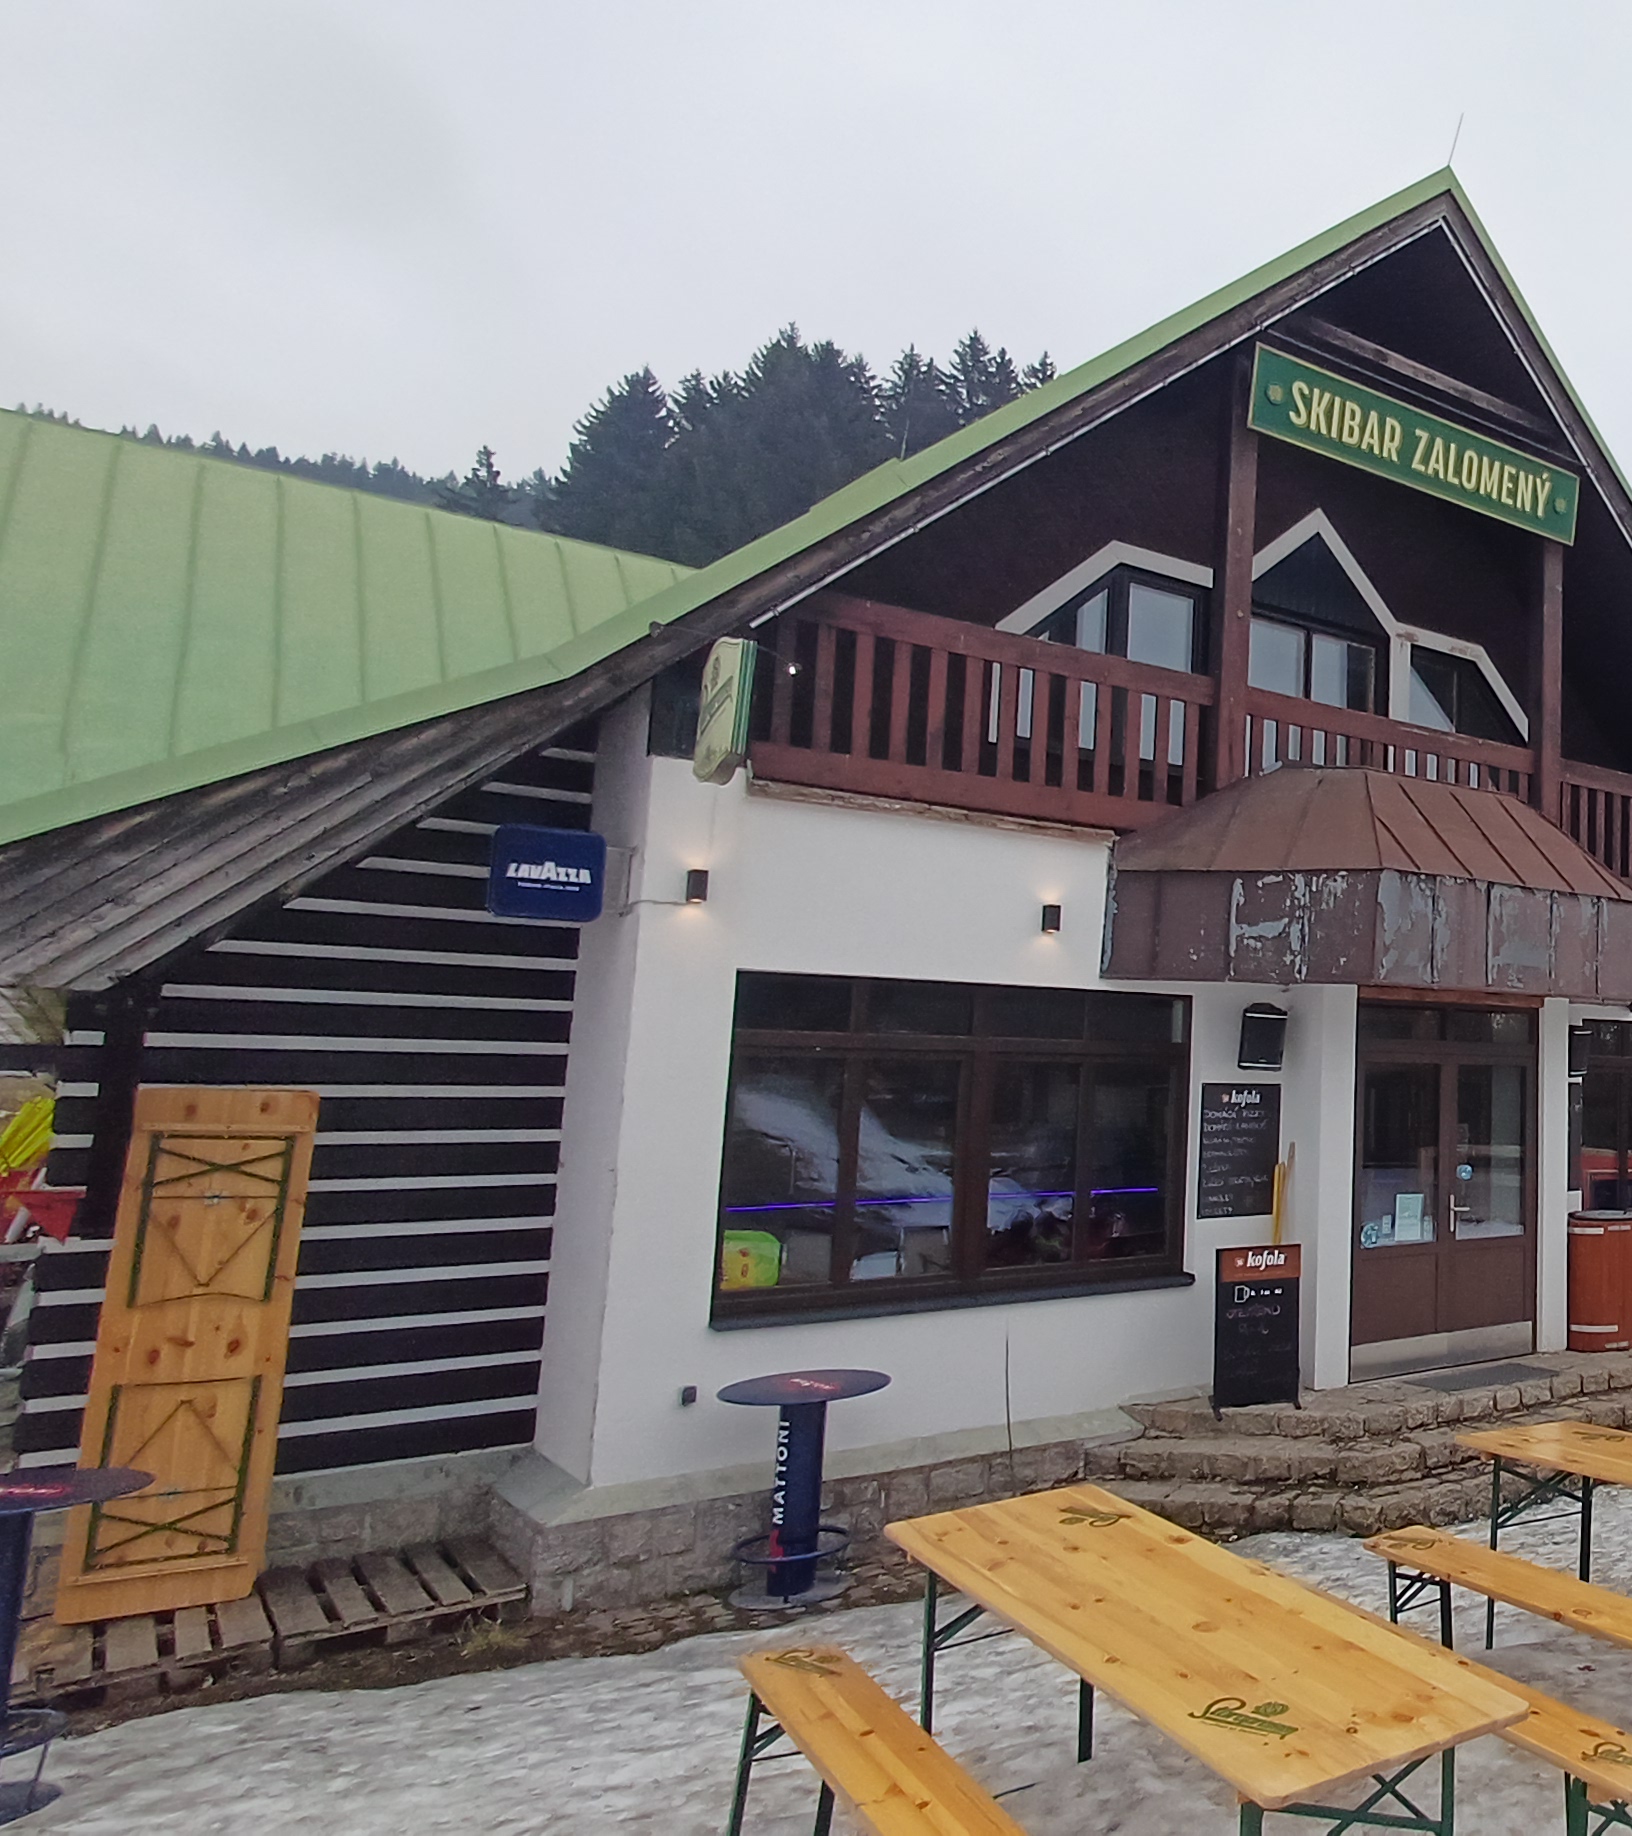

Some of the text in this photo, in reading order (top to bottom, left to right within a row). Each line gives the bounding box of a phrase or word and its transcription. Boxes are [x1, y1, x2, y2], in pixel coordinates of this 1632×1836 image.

[1288, 380, 1553, 519] SKIBAR ZALOMENÝ
[505, 860, 592, 884] LAVAZZA
[1230, 1089, 1260, 1108] kofola
[1246, 1249, 1286, 1271] kofola
[771, 1420, 791, 1526] MATTONI
